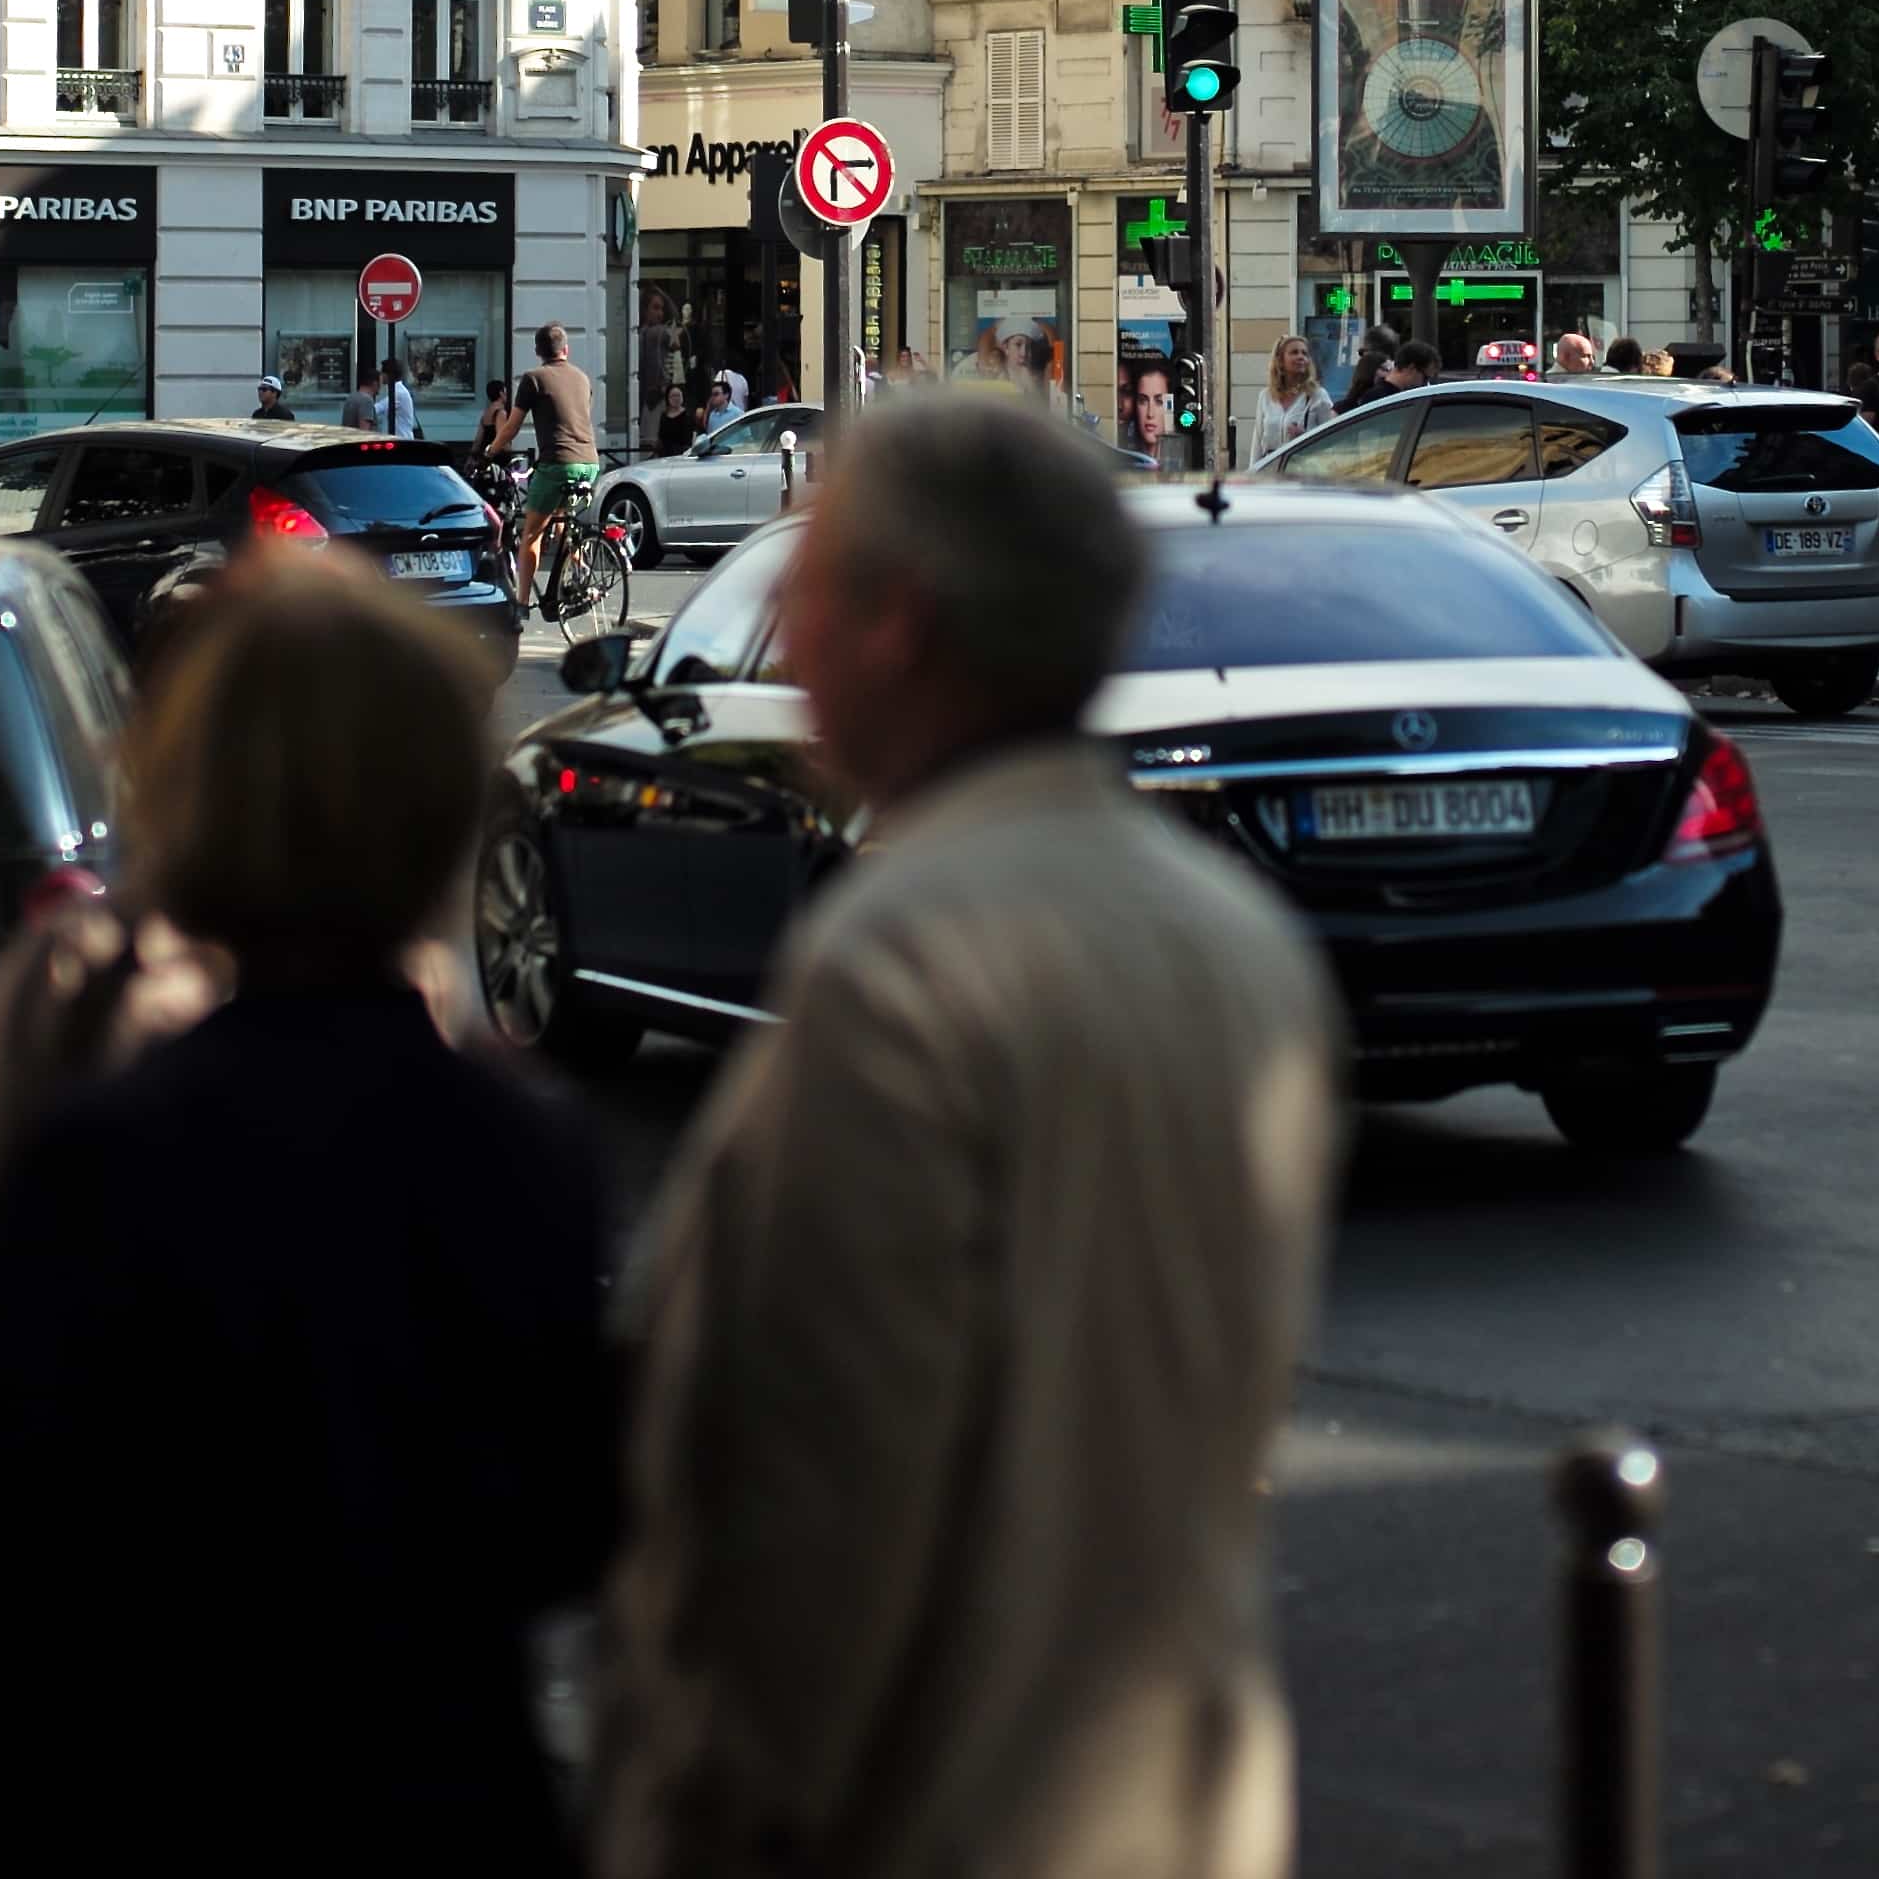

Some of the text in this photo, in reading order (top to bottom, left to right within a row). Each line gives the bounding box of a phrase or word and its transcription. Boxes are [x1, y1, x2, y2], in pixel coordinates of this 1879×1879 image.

[290, 197, 498, 224] BNP PARIBAS
[1377, 238, 1542, 266] PMACIE
[865, 244, 883, 359] Apparel rican
